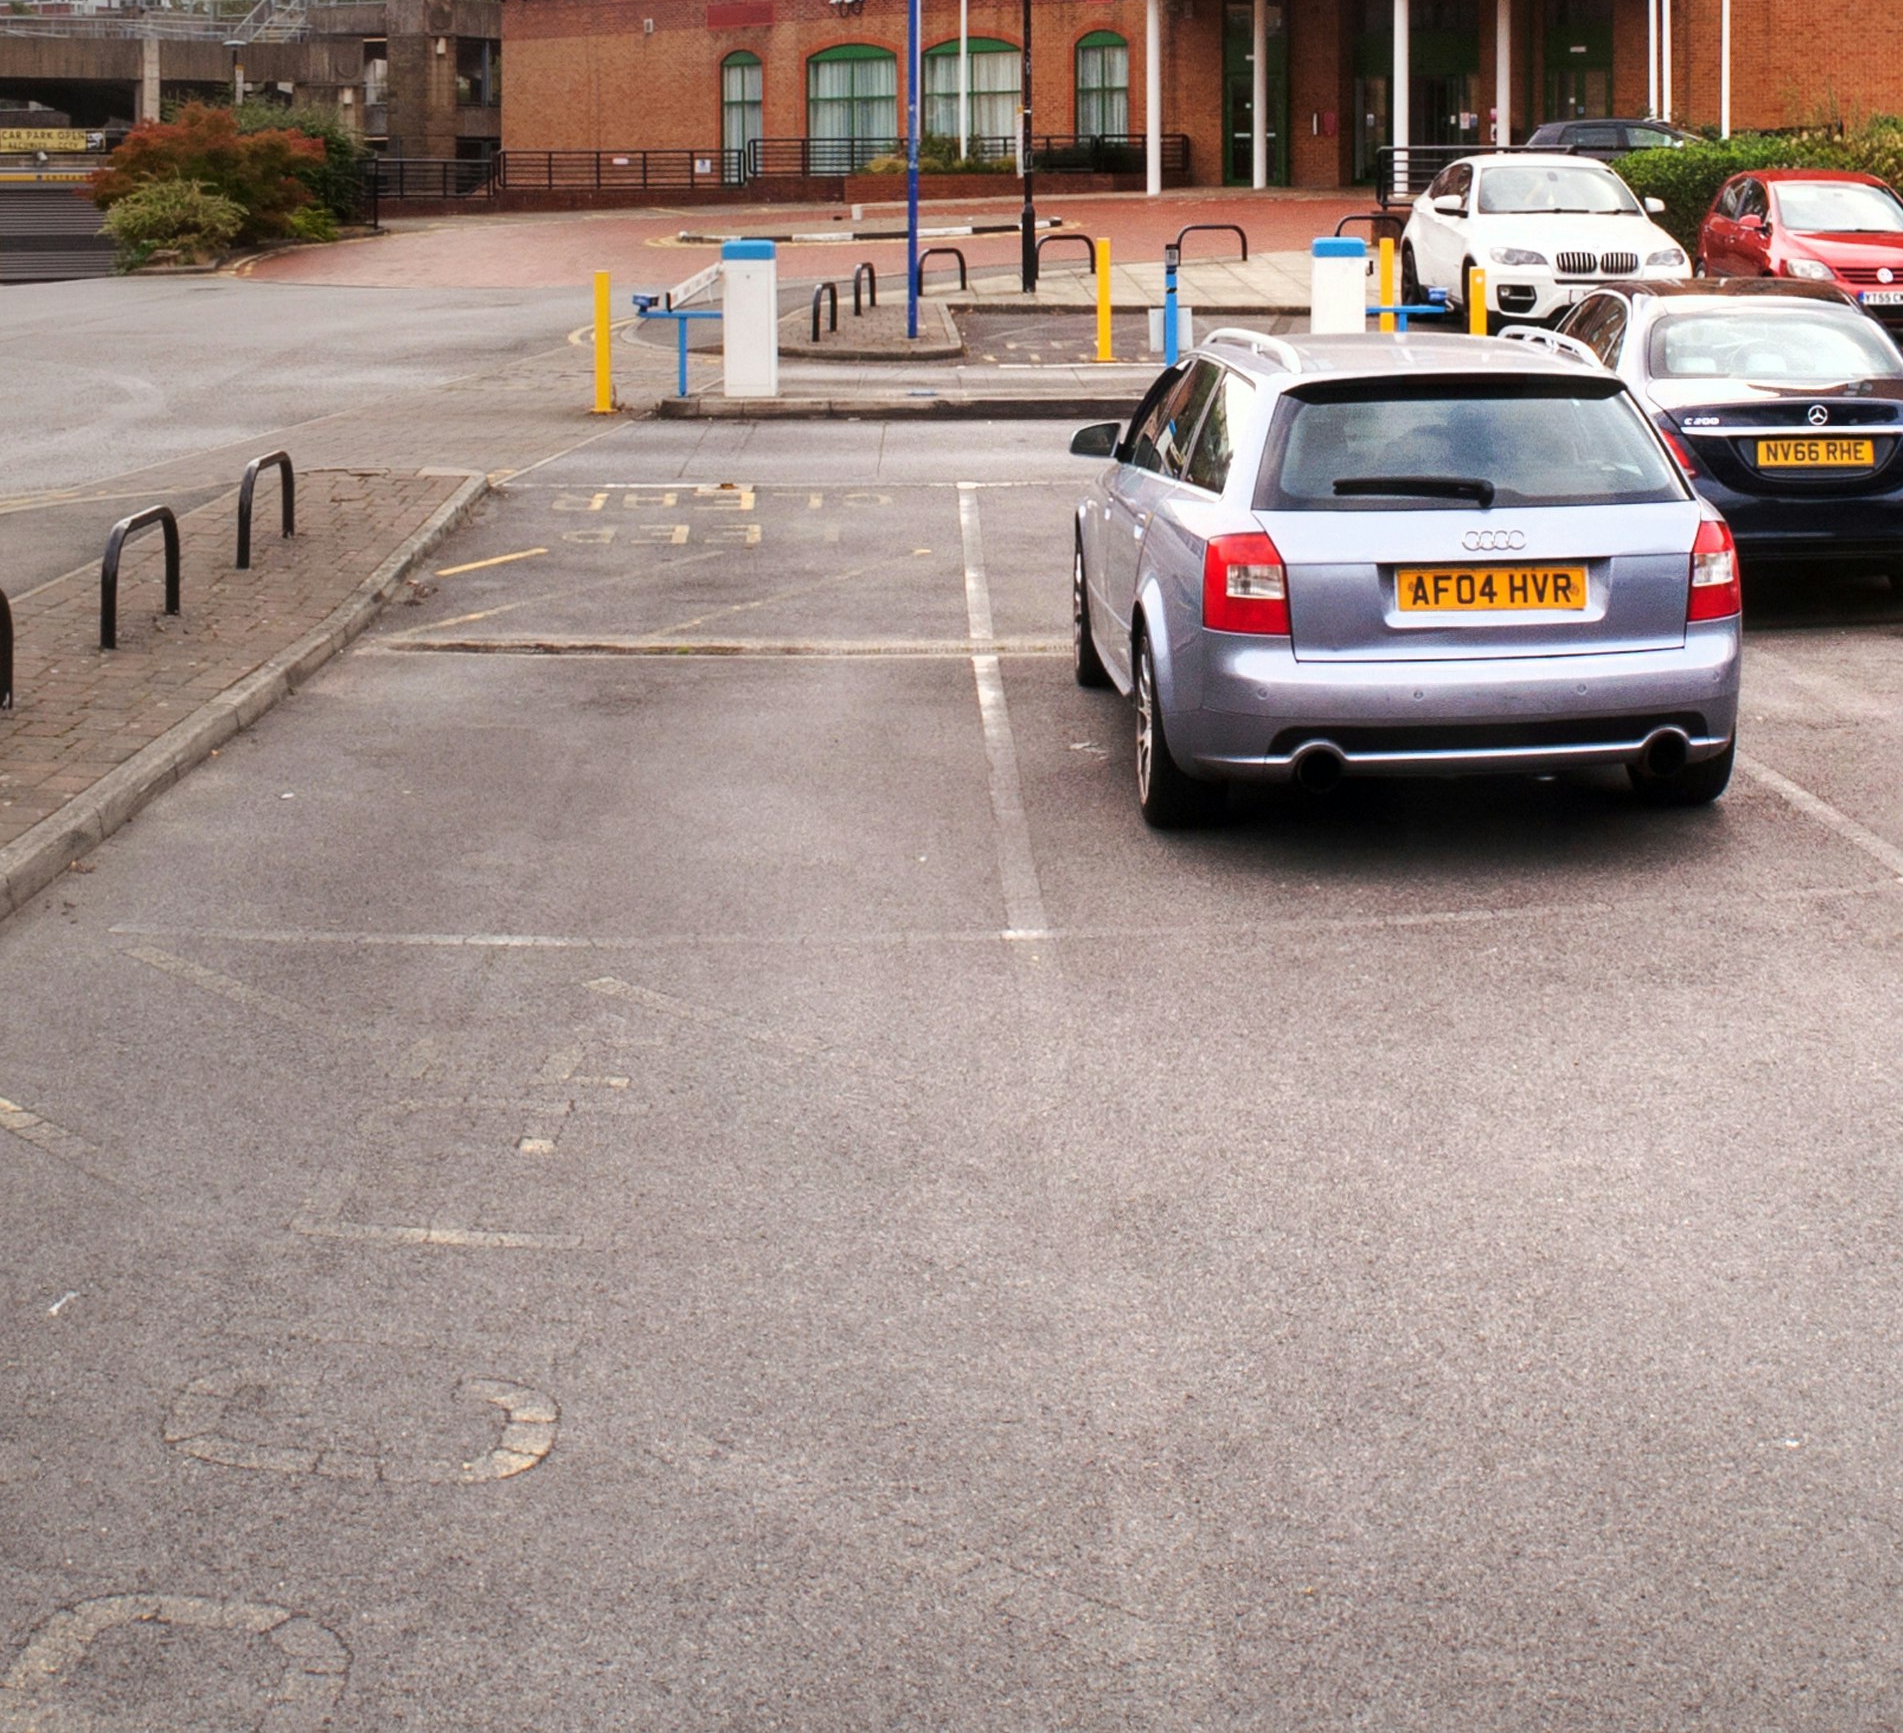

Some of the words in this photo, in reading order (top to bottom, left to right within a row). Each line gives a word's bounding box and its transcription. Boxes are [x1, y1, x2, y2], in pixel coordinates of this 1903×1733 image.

[1, 130, 23, 140] CAR
[26, 130, 53, 140] PARK
[57, 130, 85, 140] OPEN
[1766, 442, 1819, 462] NV66
[1825, 441, 1865, 461] RHE
[1412, 575, 1498, 606] AF04
[1508, 573, 1572, 604] HVR
